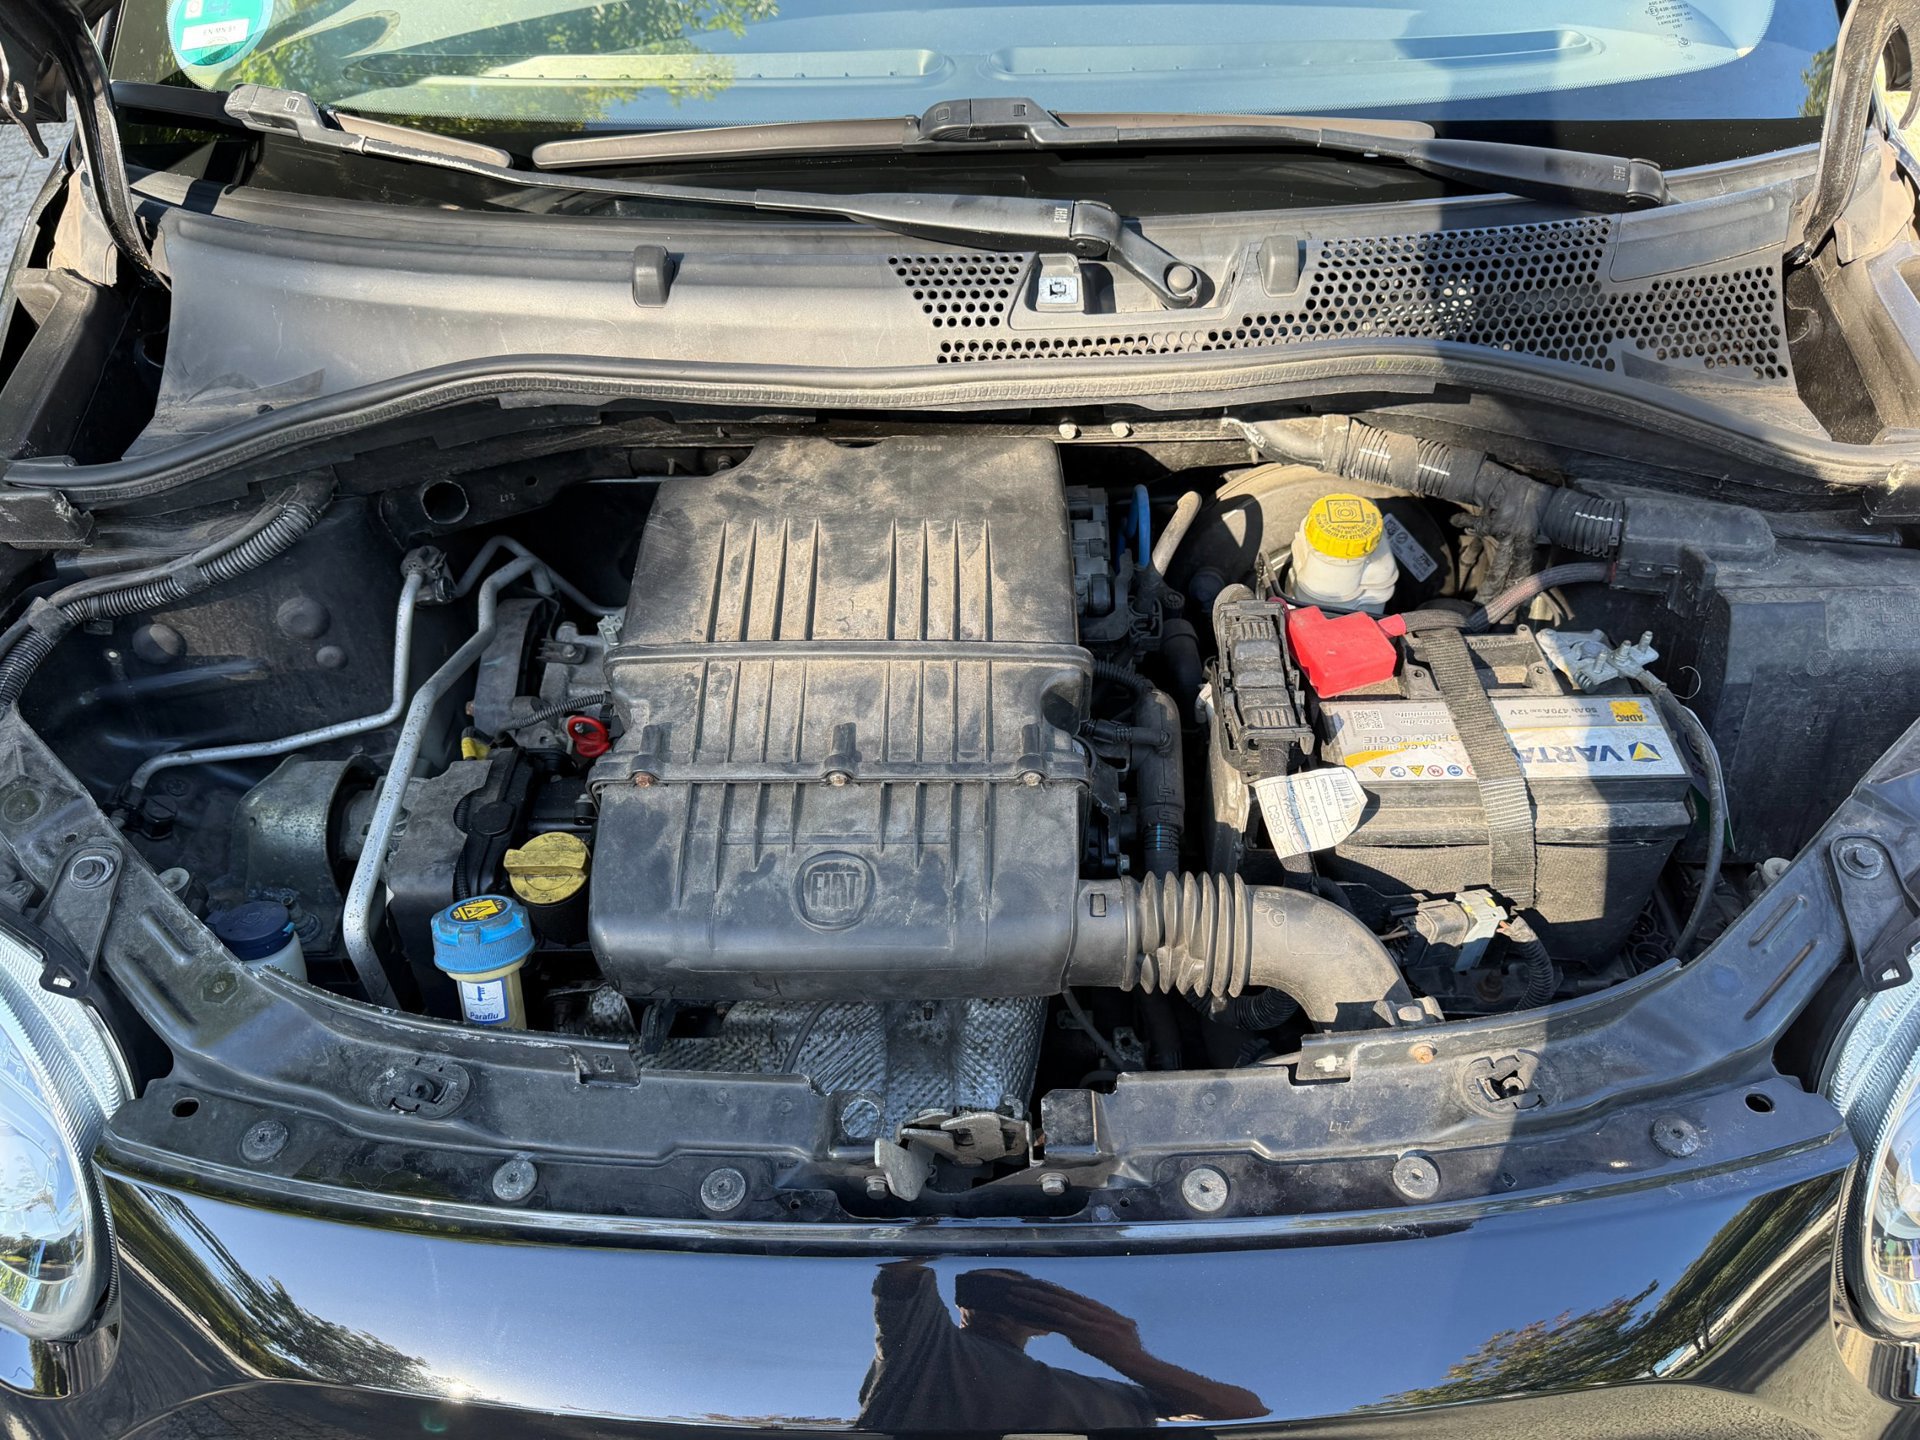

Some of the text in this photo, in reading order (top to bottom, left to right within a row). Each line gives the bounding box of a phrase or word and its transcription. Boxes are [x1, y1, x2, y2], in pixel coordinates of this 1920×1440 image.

[1615, 714, 1644, 723] ADAC
[1511, 745, 1625, 764] VARTA
[810, 871, 860, 911] FIAT
[470, 1011, 499, 1021] Paraflu
